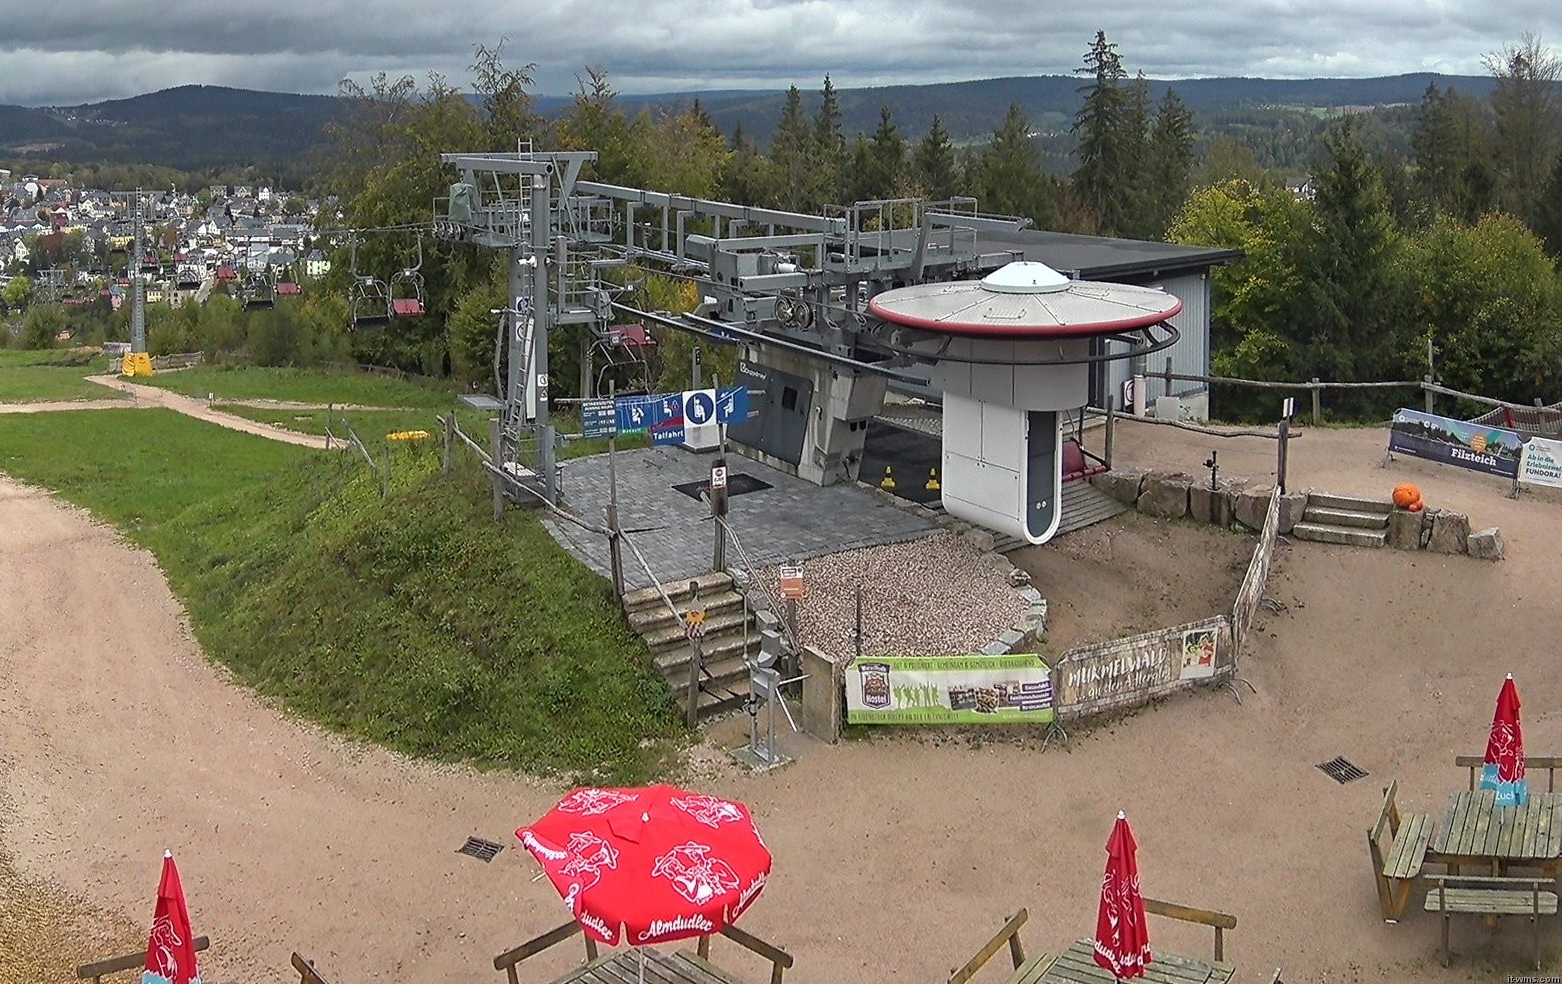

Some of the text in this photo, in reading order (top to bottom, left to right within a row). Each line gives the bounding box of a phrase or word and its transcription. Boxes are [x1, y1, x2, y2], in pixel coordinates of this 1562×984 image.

[653, 430, 684, 440] Talfahrt
[1451, 448, 1497, 467] Filzteich
[639, 914, 713, 941] Almdudler
